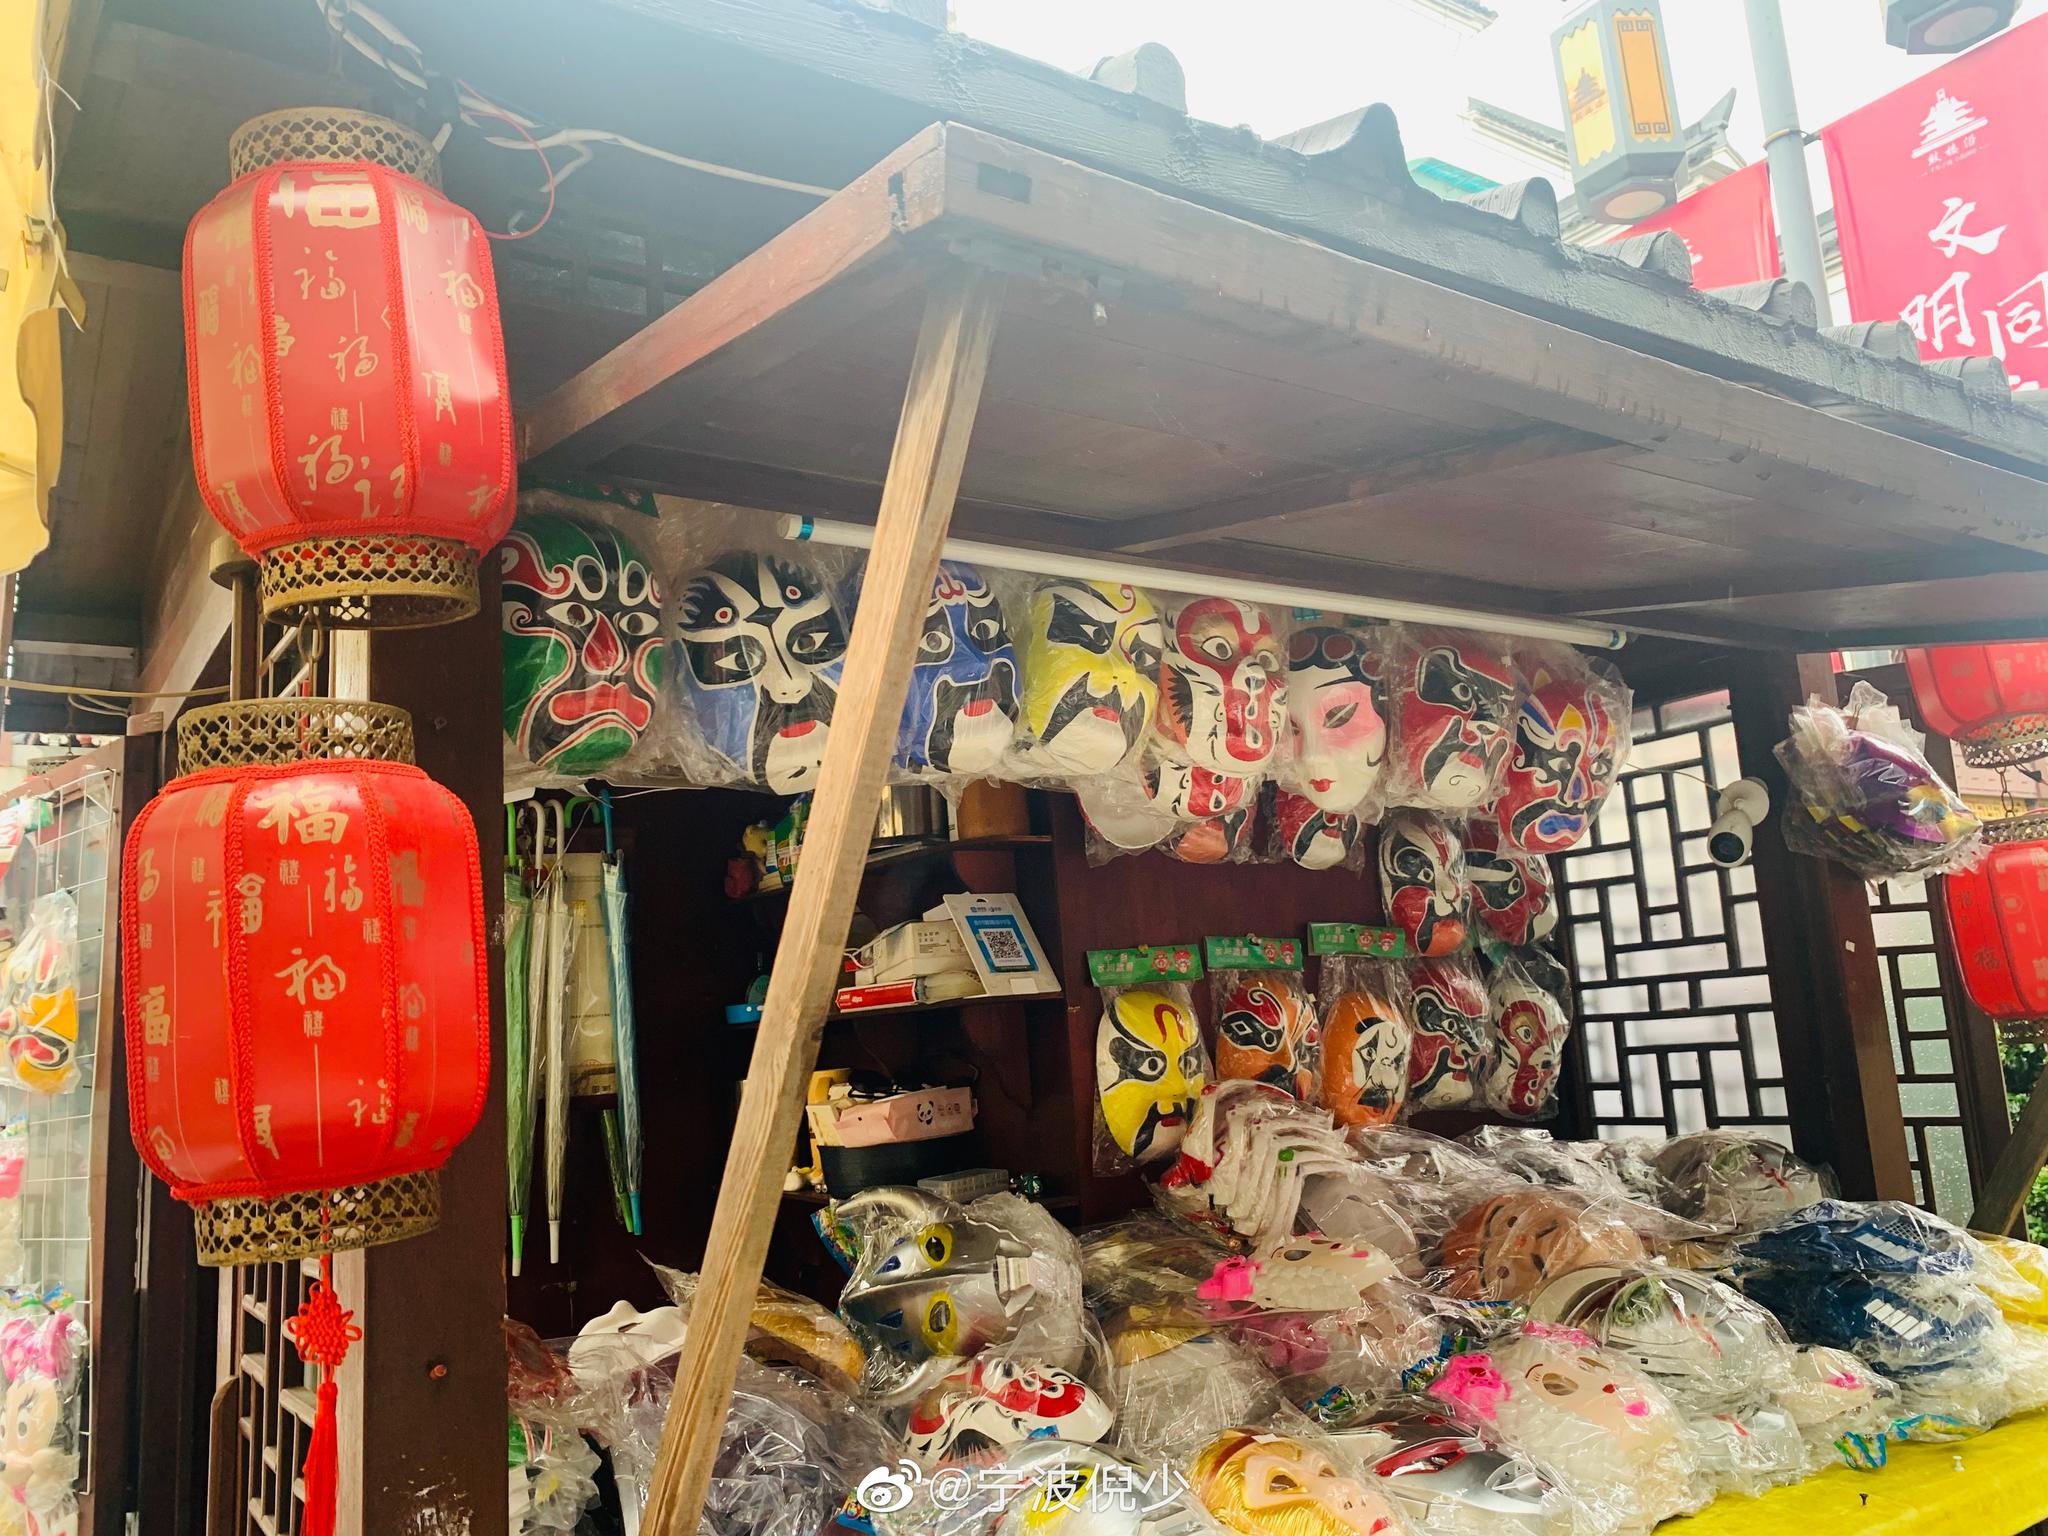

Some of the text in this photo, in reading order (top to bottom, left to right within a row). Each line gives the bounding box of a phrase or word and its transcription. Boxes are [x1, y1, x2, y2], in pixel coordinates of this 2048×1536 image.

[1898, 197, 2009, 353] 文明
[254, 779, 350, 846] 福
[274, 947, 347, 1006] 福
